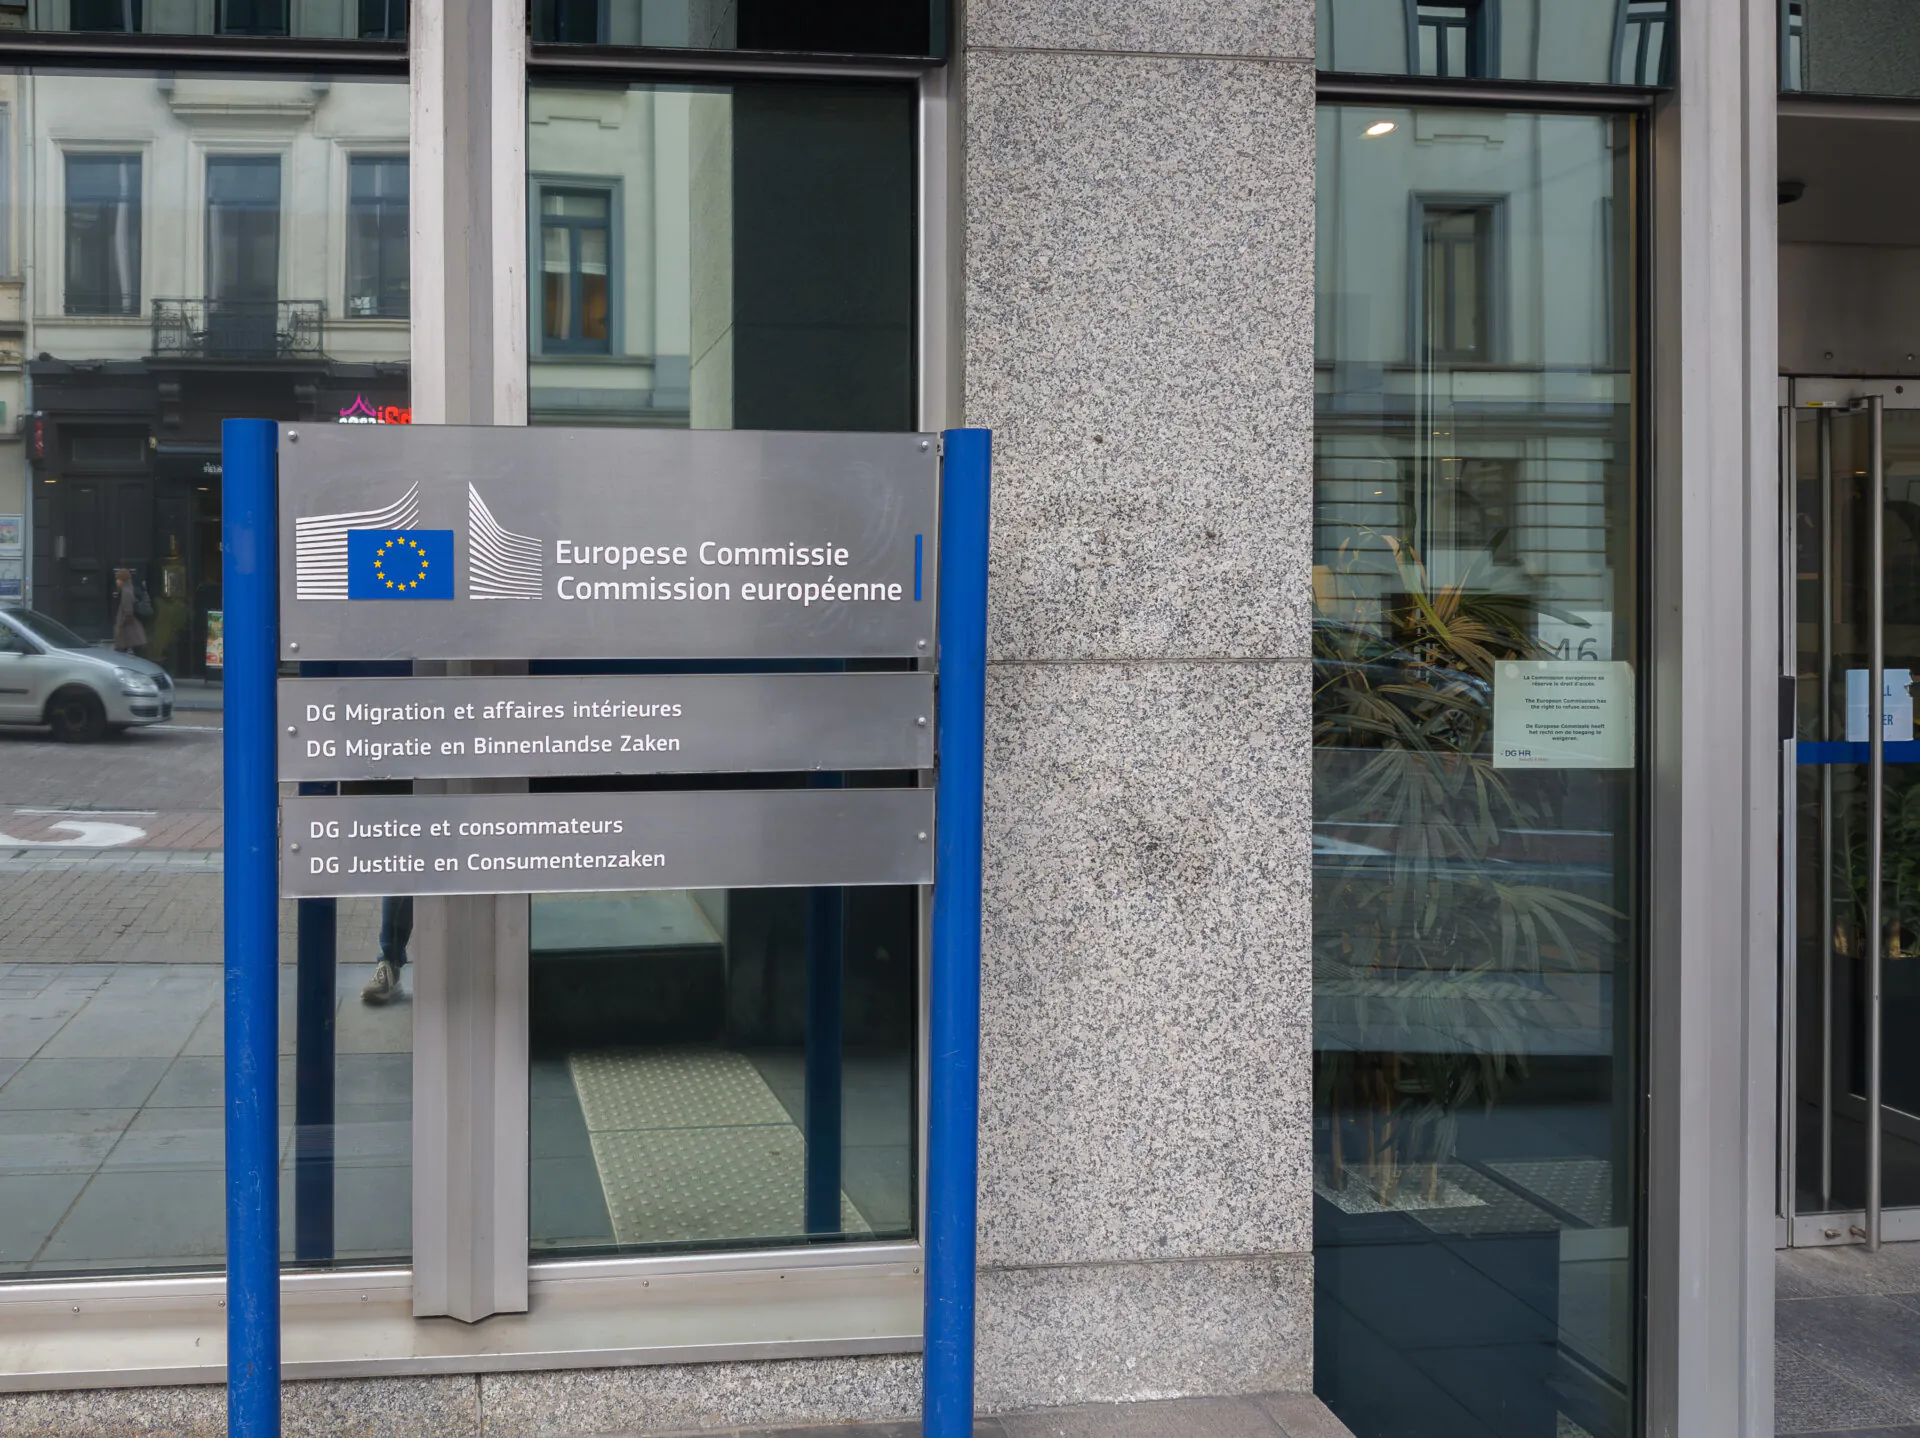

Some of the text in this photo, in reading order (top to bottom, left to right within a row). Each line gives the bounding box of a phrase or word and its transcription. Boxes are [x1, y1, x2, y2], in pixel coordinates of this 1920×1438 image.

[556, 539, 849, 571] Europese Commissie
[557, 574, 903, 607] Commission européenne
[306, 698, 682, 726] DG Migration et affaires intérieures
[306, 733, 680, 761] DG Migratie en Binnenlandse Zaken
[1505, 749, 1532, 757] DG HR
[310, 816, 624, 839] DG Justice et consommateurs
[310, 849, 666, 874] DG Justitie en Consumentenzaken
